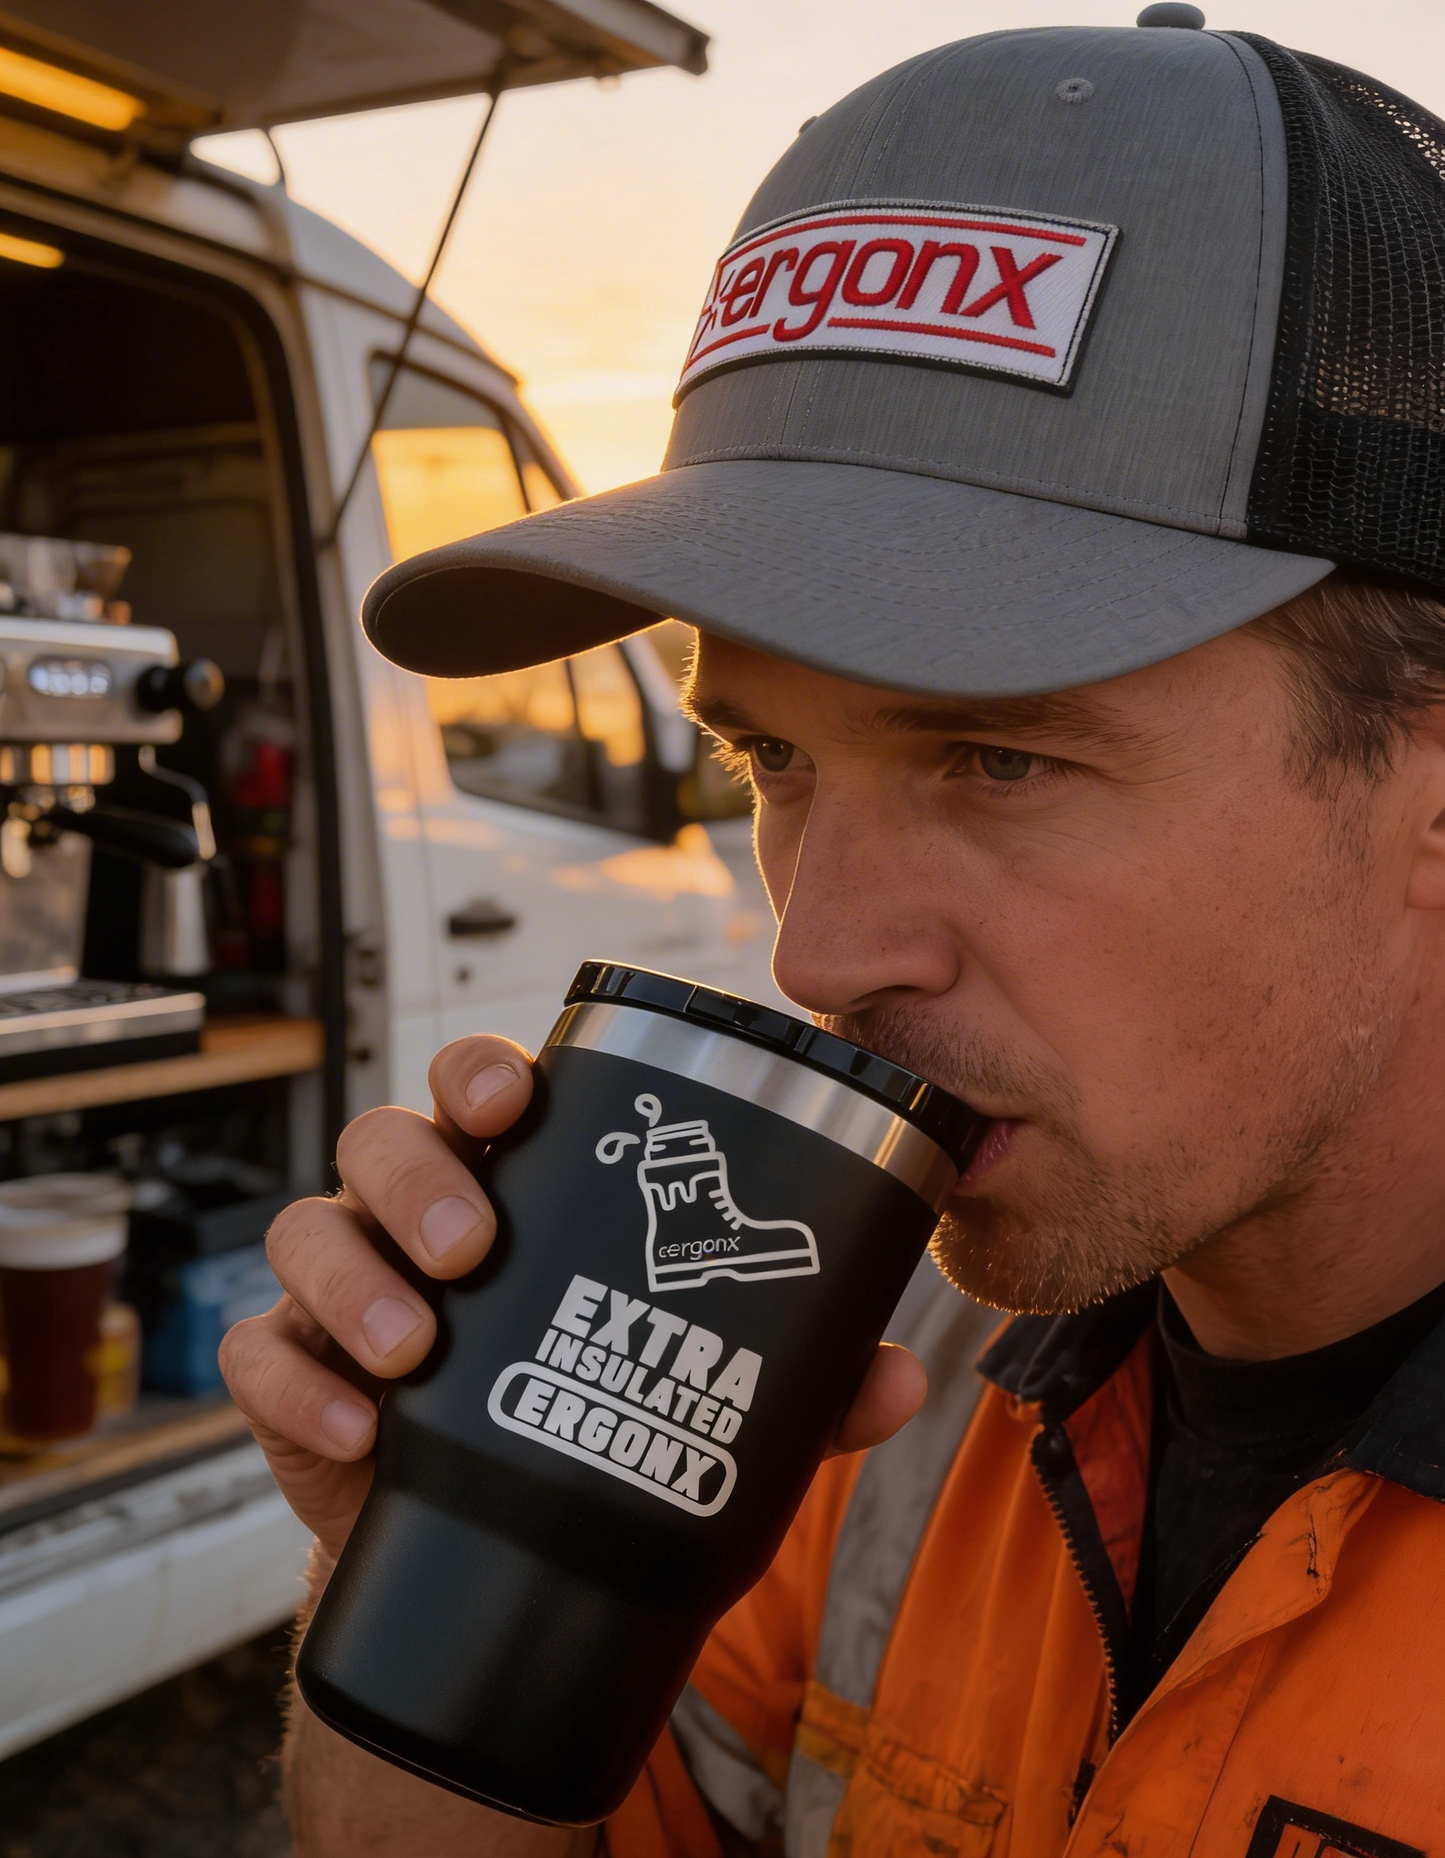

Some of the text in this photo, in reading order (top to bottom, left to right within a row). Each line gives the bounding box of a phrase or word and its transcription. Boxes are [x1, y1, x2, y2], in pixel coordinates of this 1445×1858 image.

[534, 1328, 744, 1445] INSULATED
[551, 1274, 764, 1412] EXTRA
[513, 1377, 716, 1501] ERGONX
